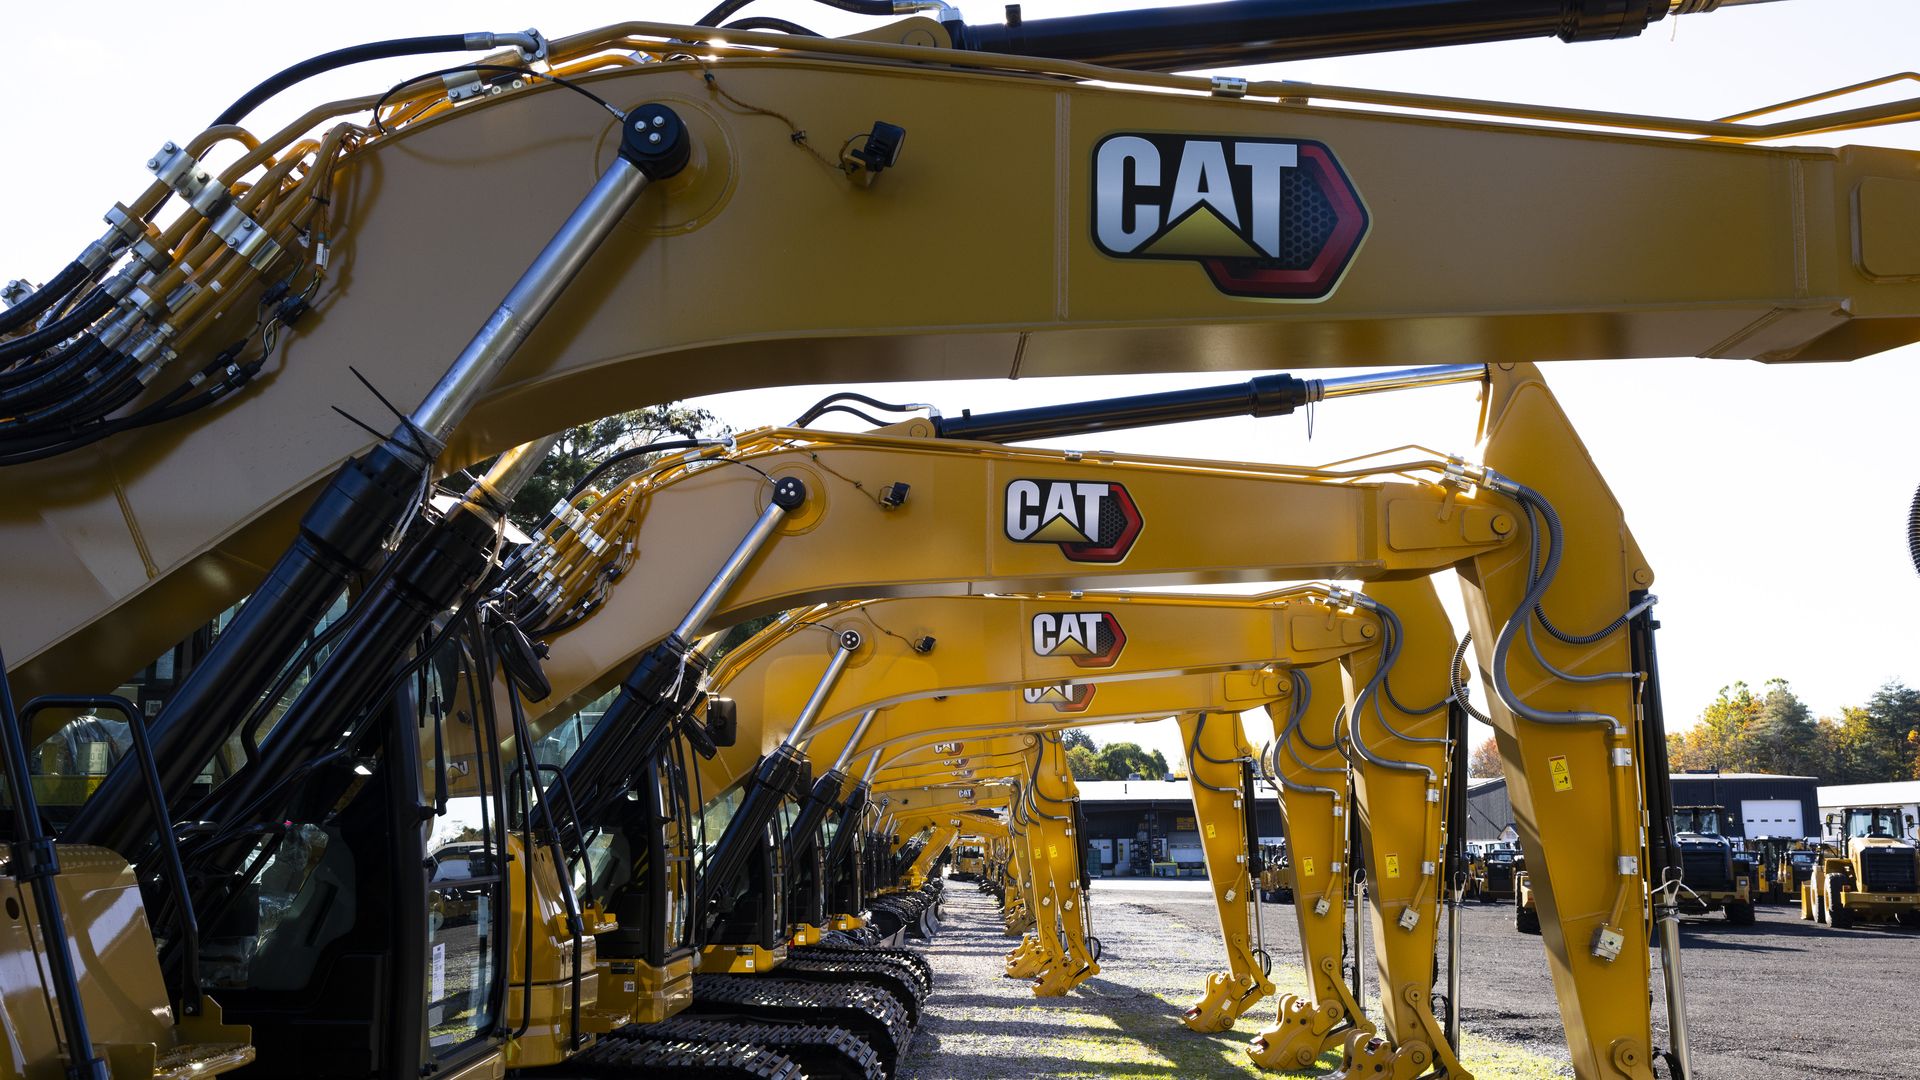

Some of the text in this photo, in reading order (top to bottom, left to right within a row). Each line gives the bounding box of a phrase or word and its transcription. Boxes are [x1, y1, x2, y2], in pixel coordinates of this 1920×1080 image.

[1097, 136, 1297, 258] CAT
[1007, 480, 1108, 542] CAT
[1033, 613, 1102, 655] CAT
[959, 789, 971, 798] CAT
